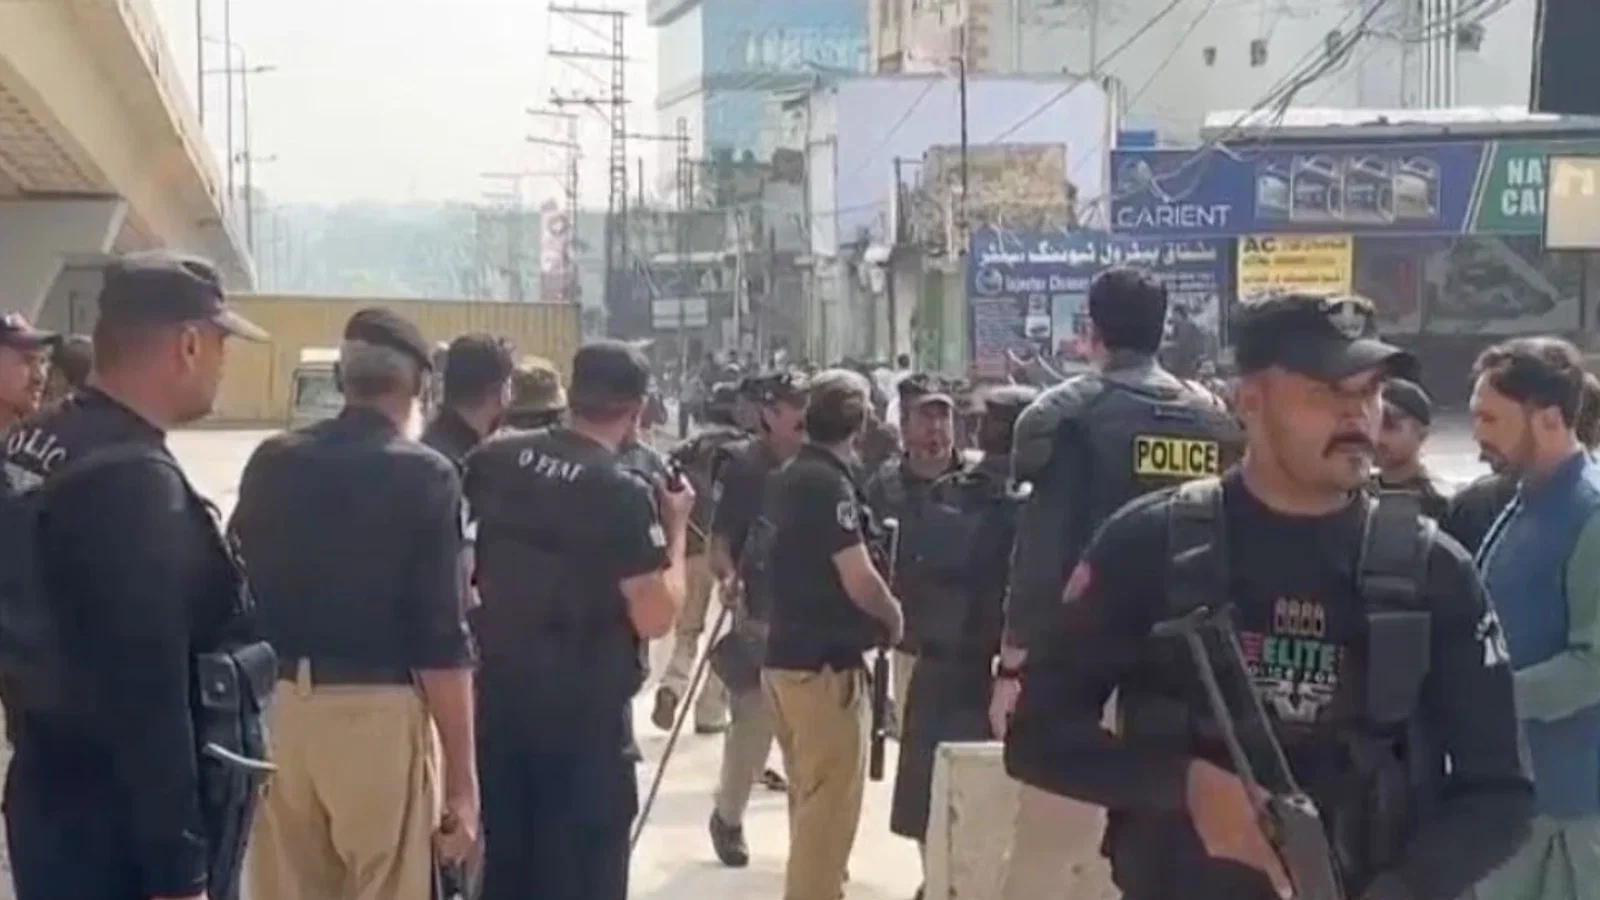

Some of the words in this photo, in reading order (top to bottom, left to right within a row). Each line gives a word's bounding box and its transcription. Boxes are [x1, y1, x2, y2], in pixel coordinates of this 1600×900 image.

[1507, 157, 1546, 186] NA
[1117, 203, 1232, 228] CARIENT
[1243, 236, 1276, 252] AC
[7, 428, 67, 472] OLIC
[1137, 440, 1216, 473] POLICE
[1262, 636, 1336, 672] ELITE
